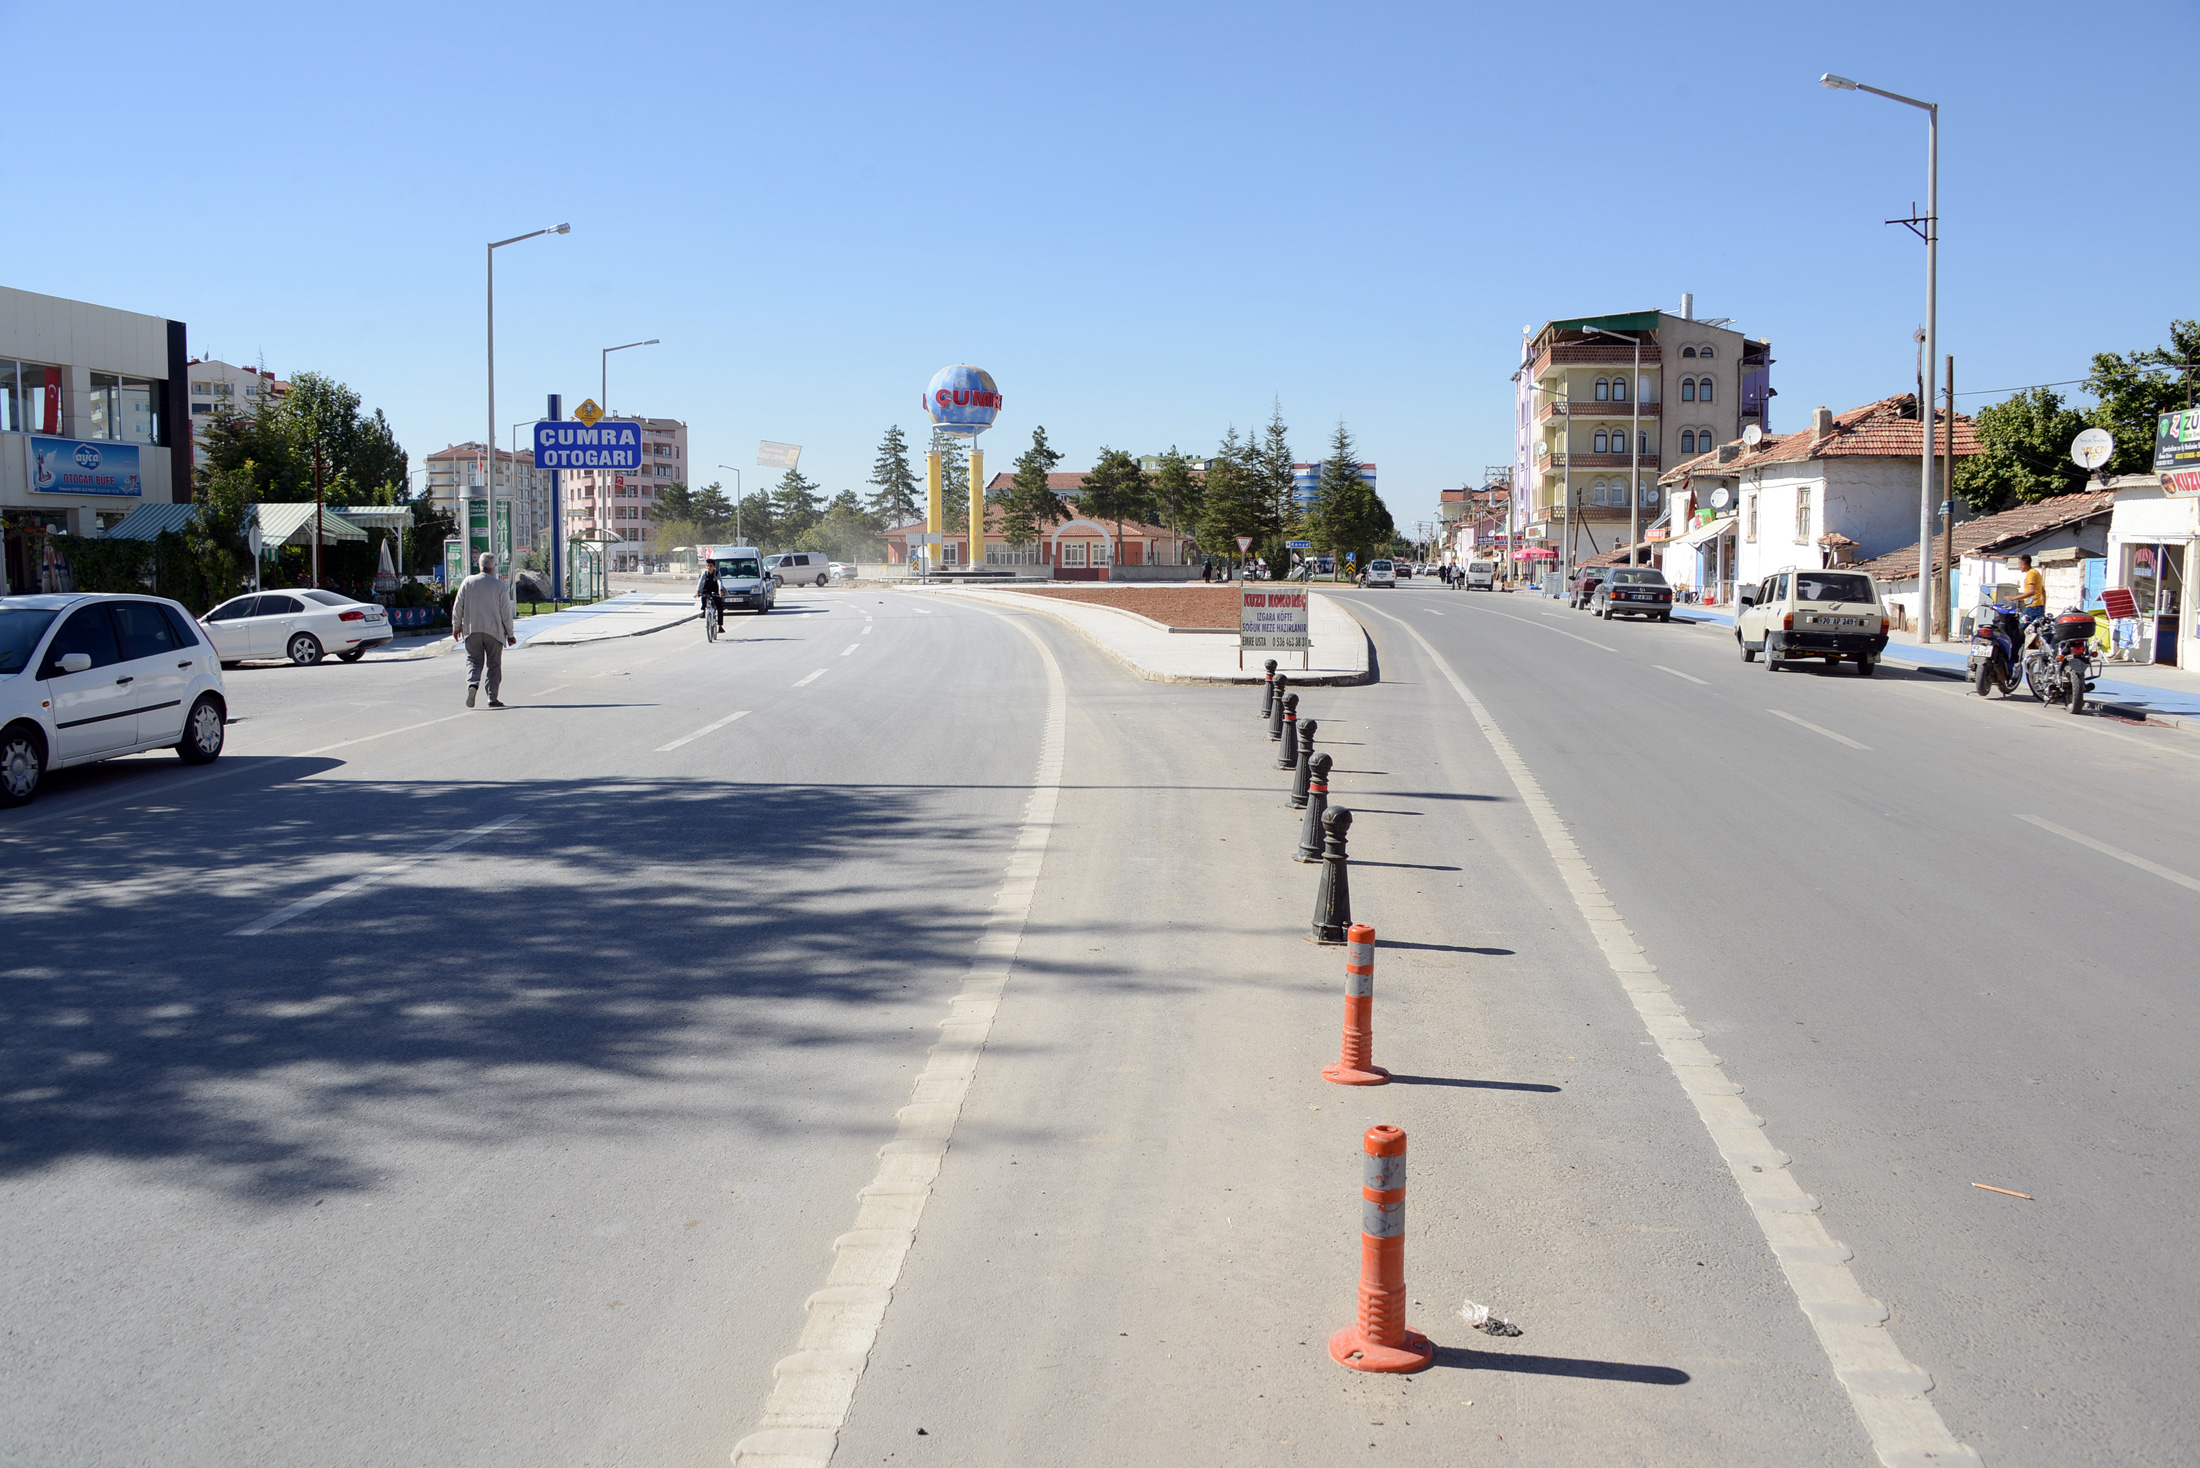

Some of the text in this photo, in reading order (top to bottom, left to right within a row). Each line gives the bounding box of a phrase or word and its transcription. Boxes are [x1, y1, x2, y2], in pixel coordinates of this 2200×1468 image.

[935, 388, 1003, 411] ÇUMR
[2183, 411, 2200, 431] ZÜ
[539, 428, 636, 447] ÇUMRA
[544, 450, 633, 466] OTOGARI
[63, 473, 115, 486] OTOGAR BÜFE
[1244, 593, 1306, 611] KUZU KOKOREÇ
[1257, 610, 1293, 622] IZGARA KÖFTE
[1242, 621, 1307, 633] SOĞUK MEZE HAZIRLANIR
[1242, 636, 1255, 646] EMRE
[1255, 637, 1266, 647] USTA
